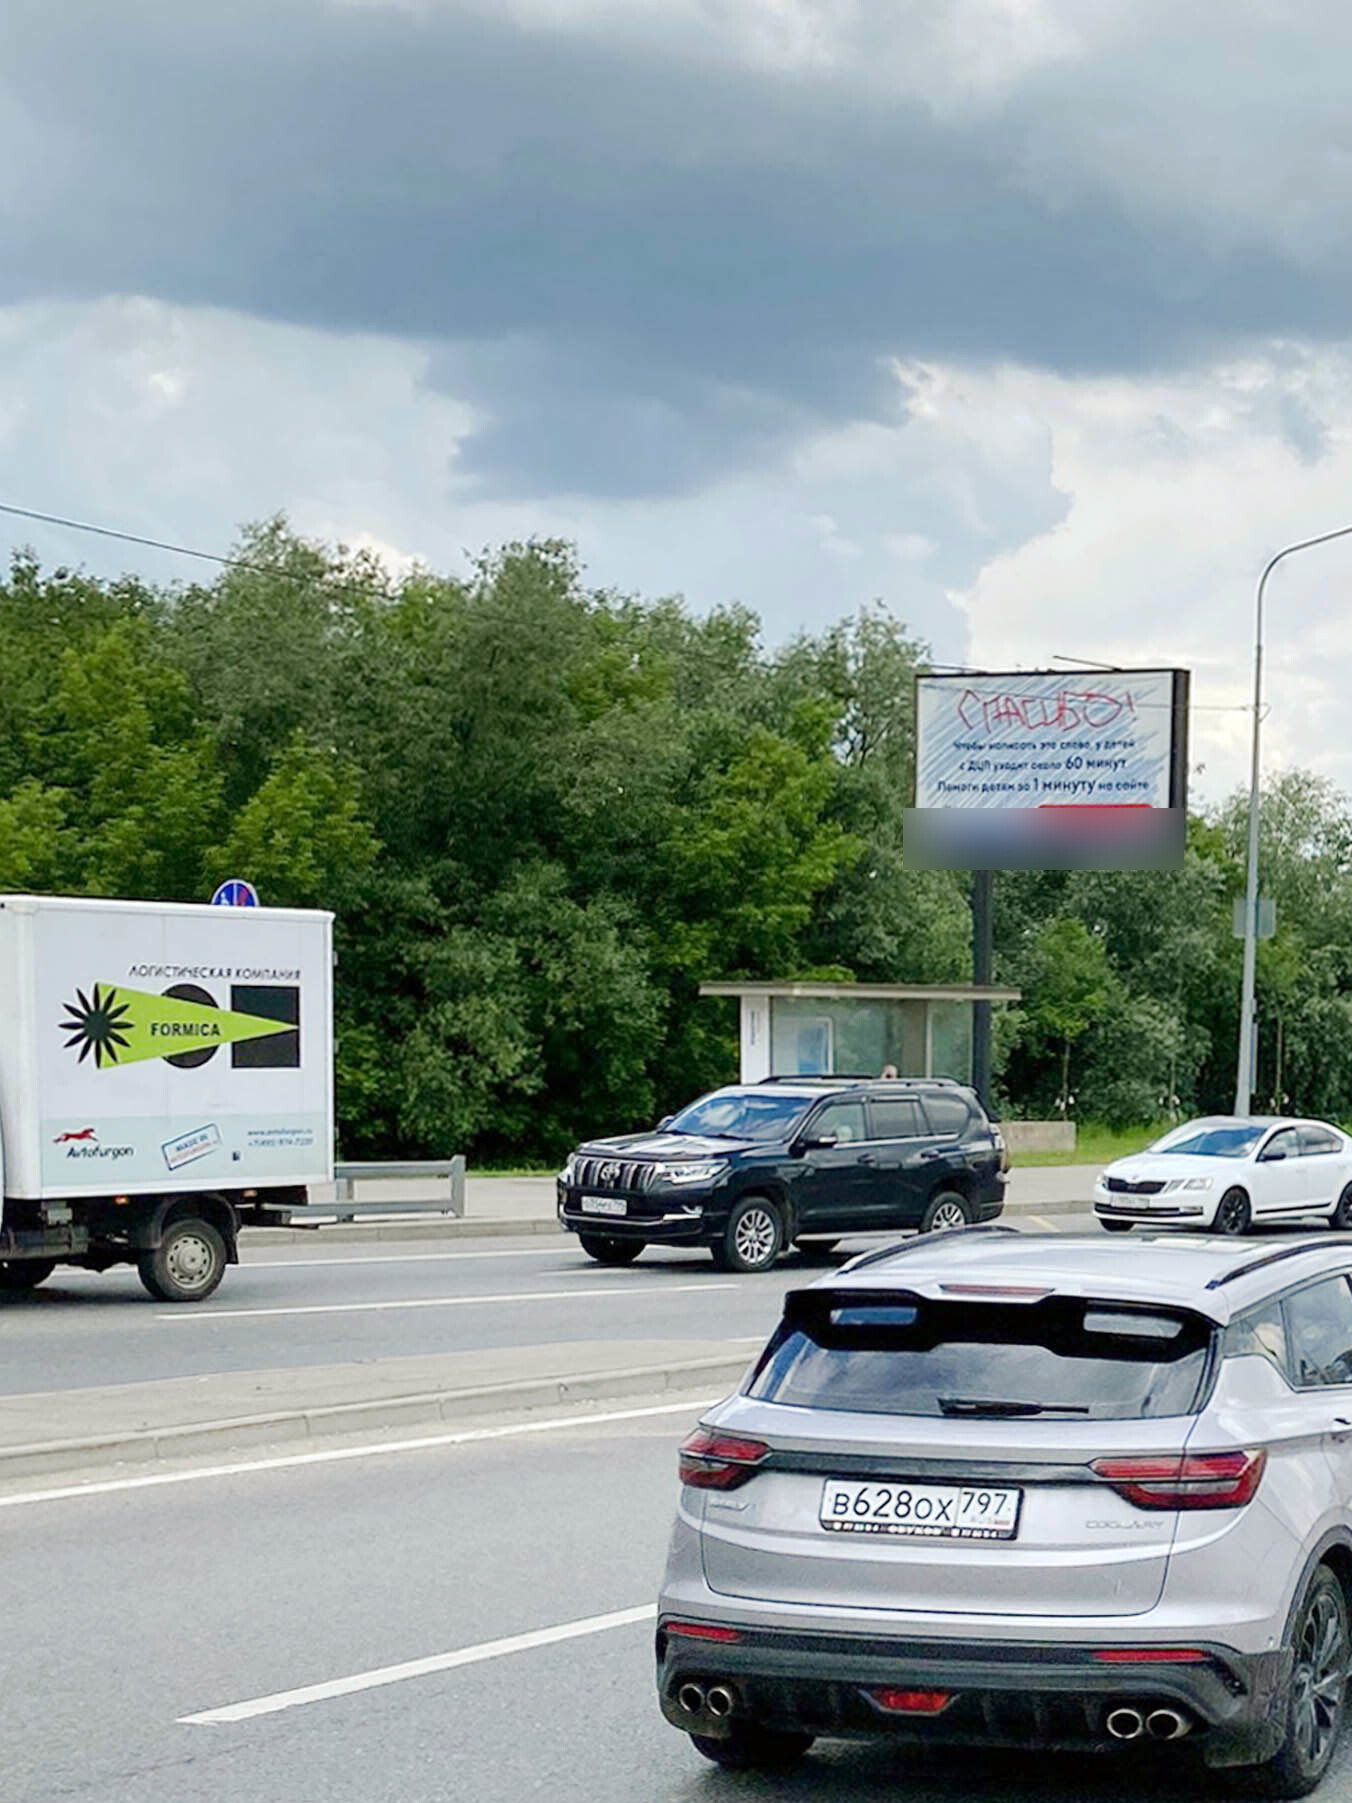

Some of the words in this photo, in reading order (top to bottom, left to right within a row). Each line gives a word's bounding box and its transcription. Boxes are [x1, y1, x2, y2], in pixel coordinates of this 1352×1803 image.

[957, 689, 1137, 733] СПАСИБО!
[967, 759, 991, 772] ДЦП
[1065, 756, 1083, 770] 60
[1086, 758, 1127, 773] минут
[937, 781, 979, 792] Помоги
[981, 781, 1015, 793] детям
[1033, 777, 1039, 792] 1
[1042, 779, 1096, 795] минуту
[1115, 778, 1149, 792] сайте
[128, 964, 232, 979] ЛОГИСТИЧЕСКАЯ
[235, 968, 301, 981] КОМПАНИЯ
[150, 1022, 221, 1037] FORMICA
[961, 1491, 1008, 1515] 797
